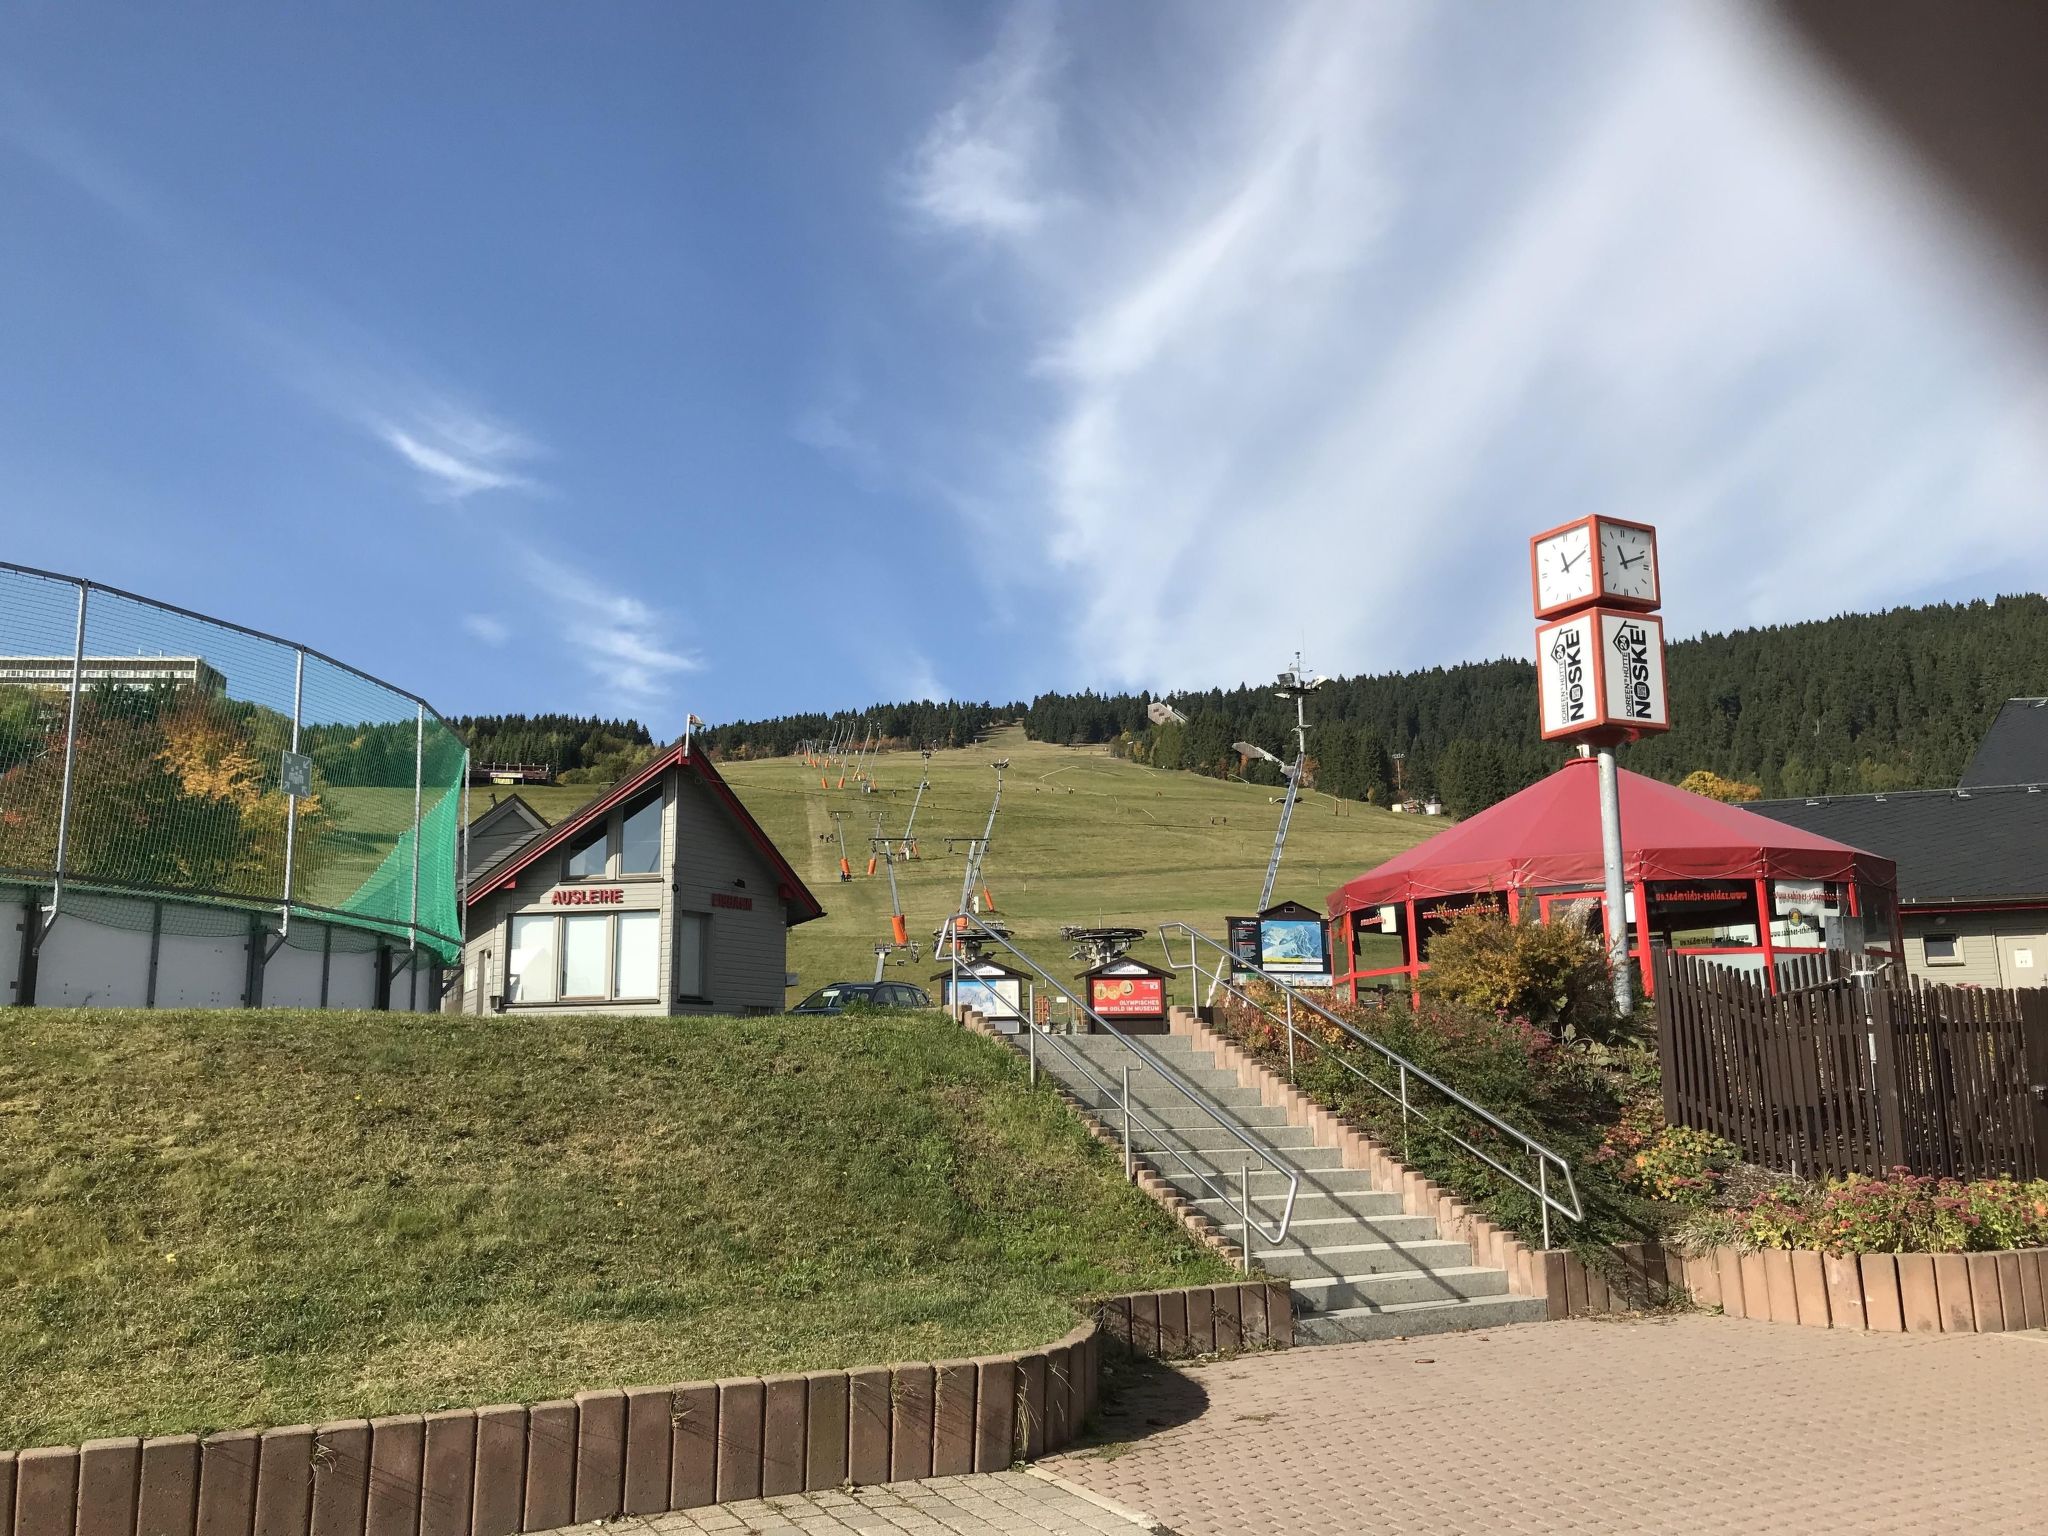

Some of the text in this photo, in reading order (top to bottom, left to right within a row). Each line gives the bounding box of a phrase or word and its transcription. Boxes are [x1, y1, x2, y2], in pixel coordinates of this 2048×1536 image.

[1565, 630, 1584, 722] NOSKE
[1621, 652, 1629, 678] HÜTTE
[1629, 629, 1651, 719] NOSKE
[551, 888, 624, 905] AUSLEIHE
